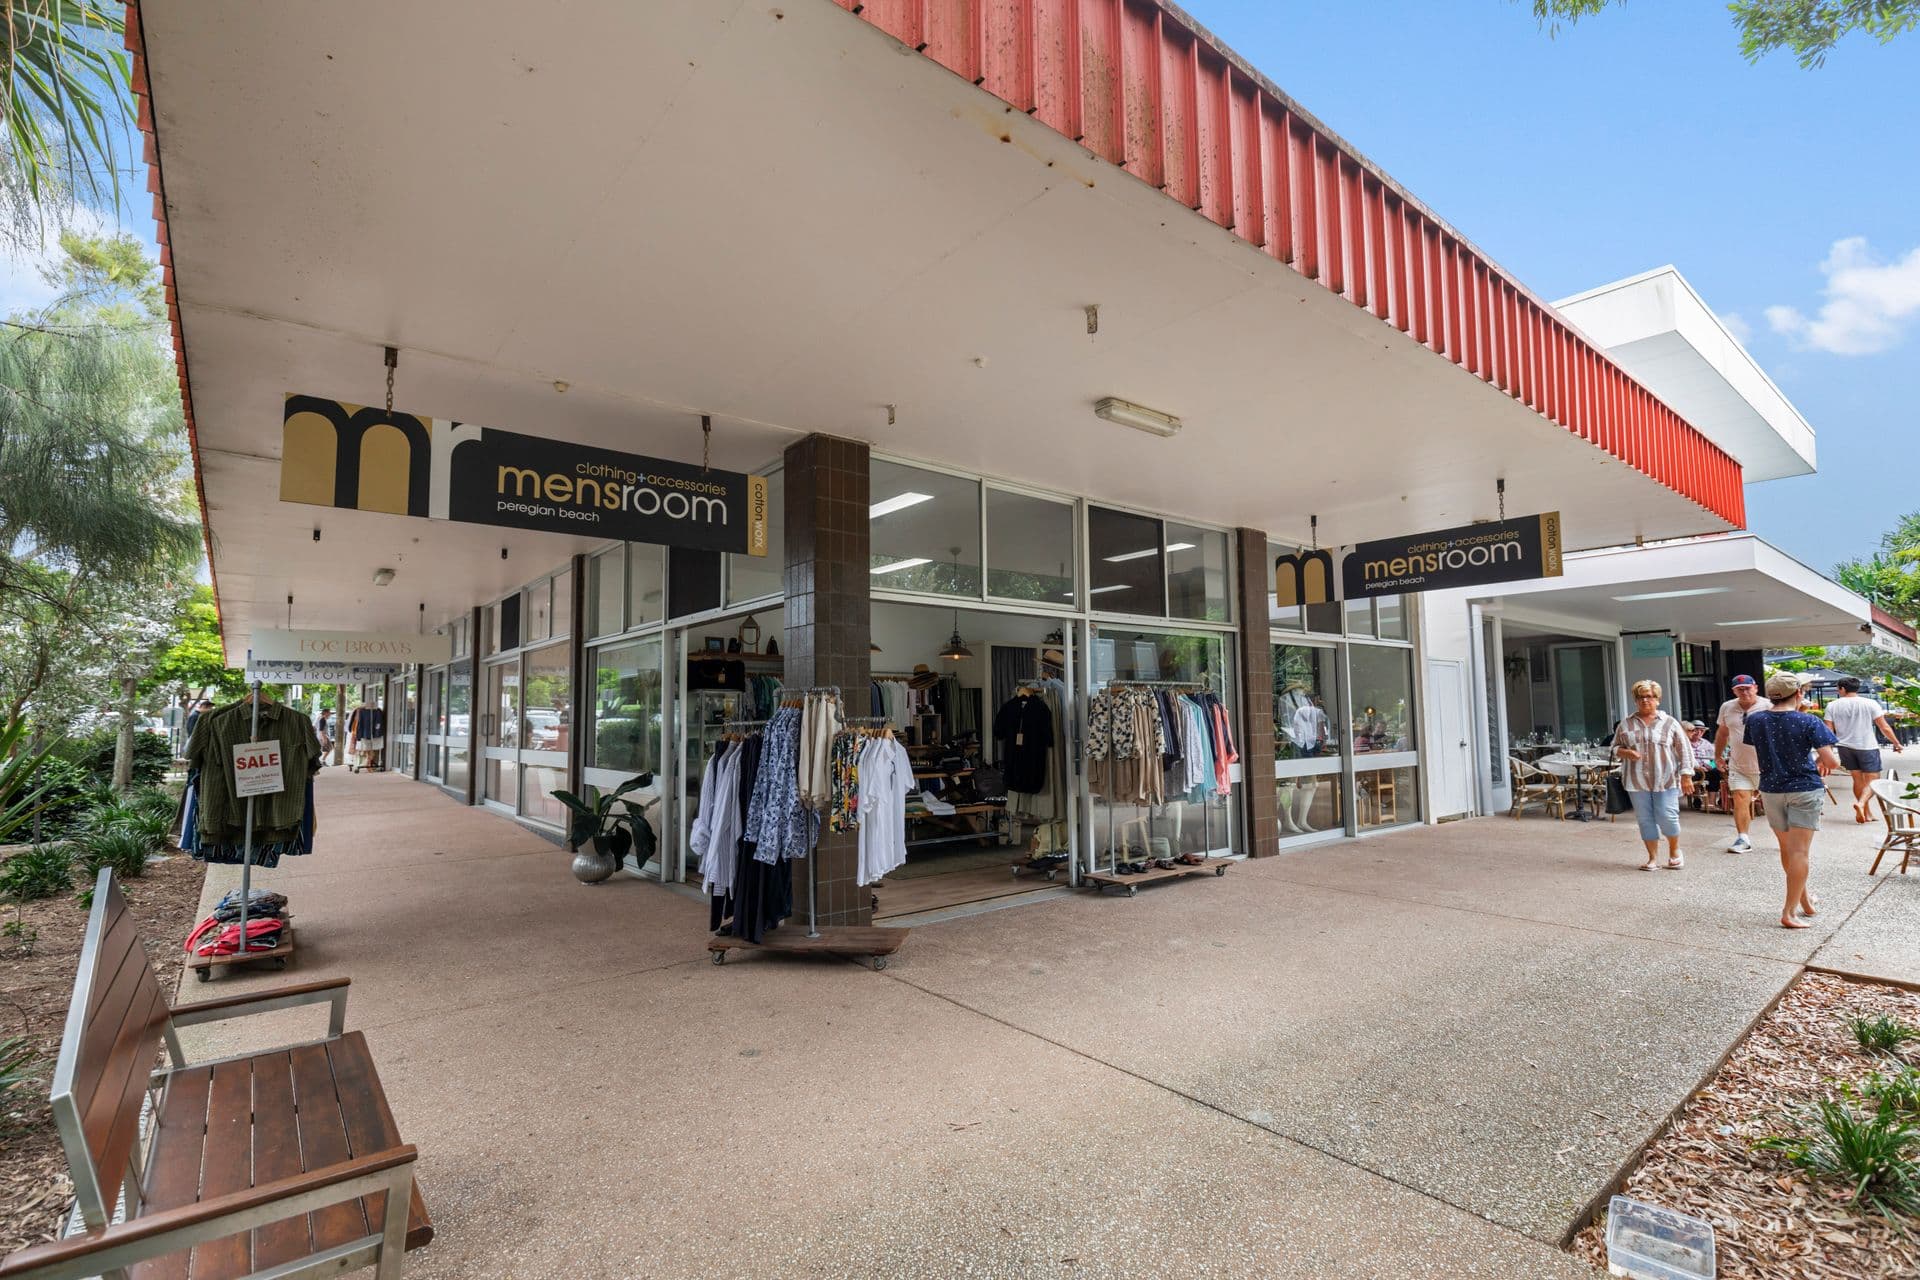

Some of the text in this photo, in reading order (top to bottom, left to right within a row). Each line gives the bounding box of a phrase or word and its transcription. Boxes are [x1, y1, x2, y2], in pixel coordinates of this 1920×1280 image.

[575, 461, 727, 497] clothing+accessories
[497, 464, 727, 525] mensroom
[497, 500, 601, 523] peregian beach
[752, 483, 764, 548] cottonworx
[1407, 530, 1520, 555] clothing+accessories
[1546, 518, 1558, 571] cottonworx
[1364, 540, 1522, 580] mensroom
[1365, 575, 1425, 590] peregian beach
[345, 639, 412, 655] BROWS
[252, 671, 293, 680] LUXE
[236, 753, 280, 770] SALE
